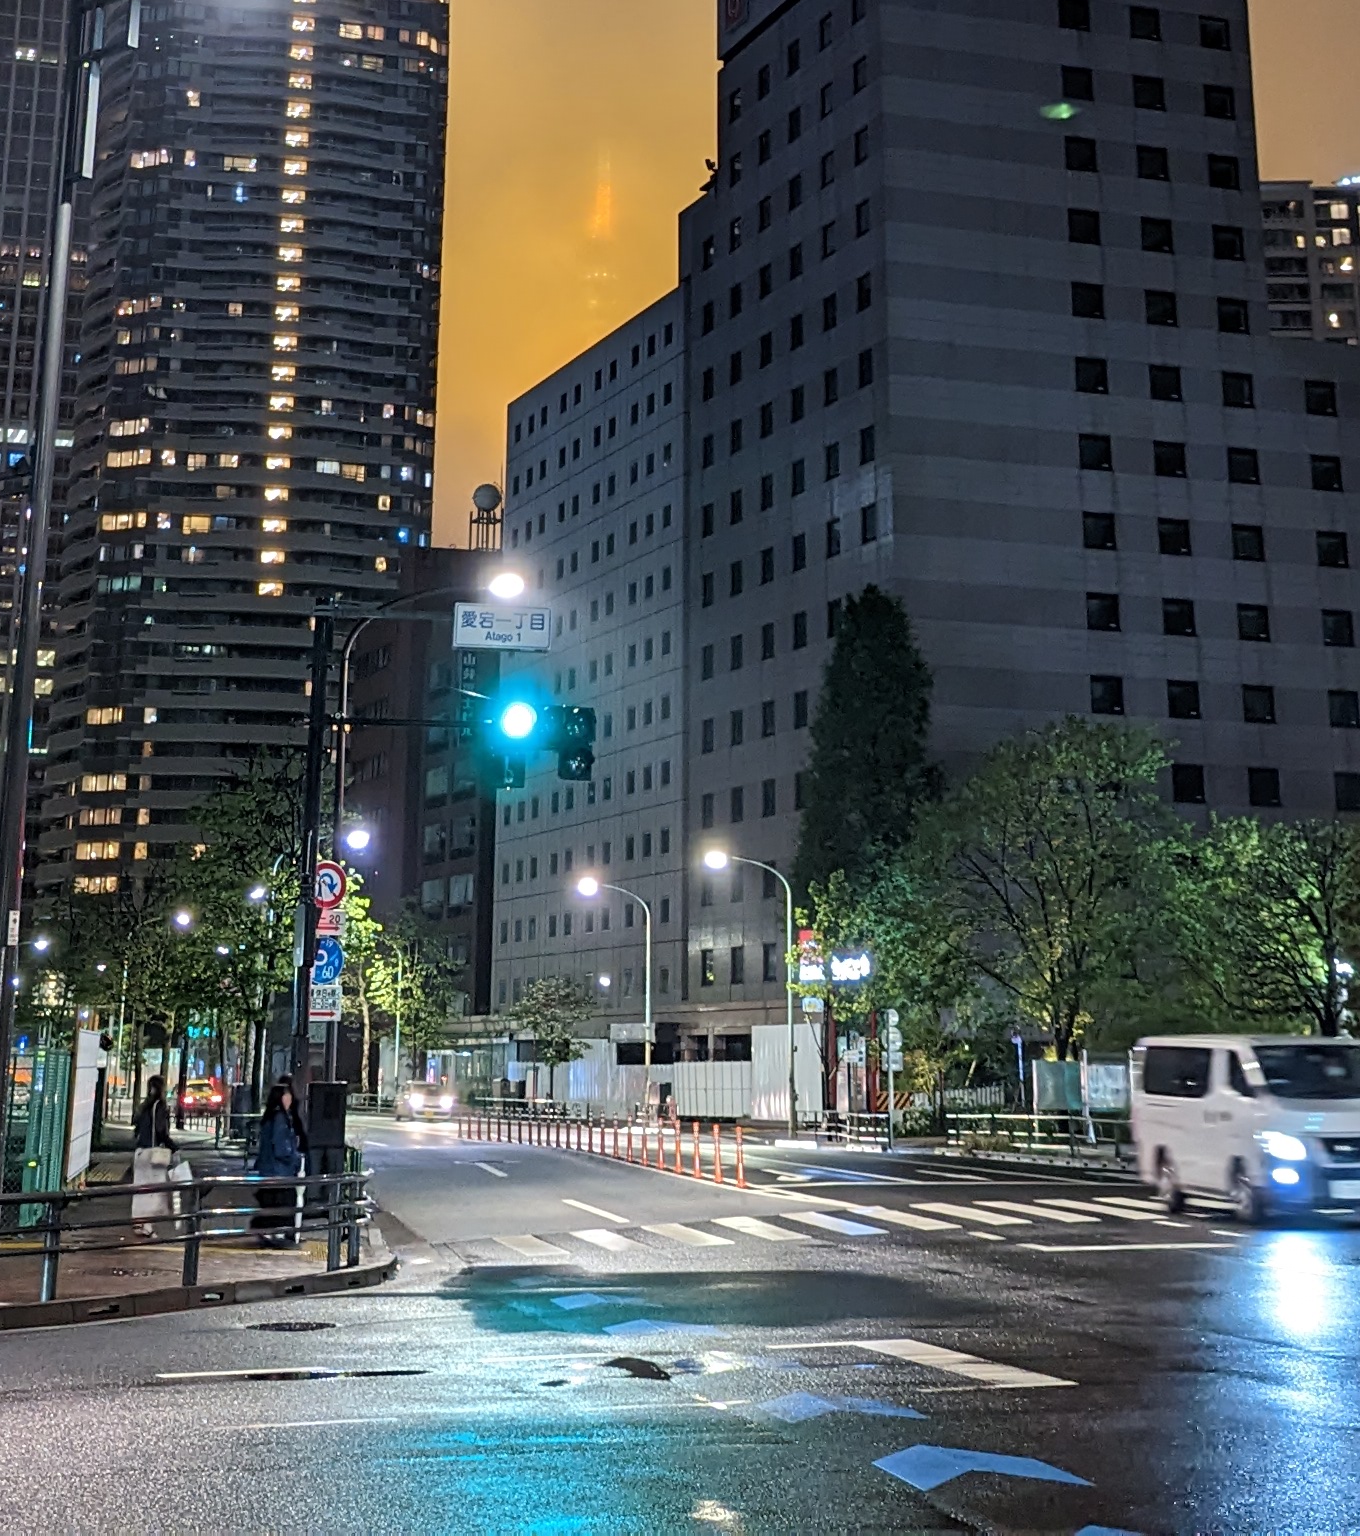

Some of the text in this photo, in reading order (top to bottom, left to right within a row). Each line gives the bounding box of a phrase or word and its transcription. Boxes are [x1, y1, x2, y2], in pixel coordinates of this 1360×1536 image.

[461, 610, 545, 631] 愛宕一丁目
[485, 631, 522, 644] Atago 1
